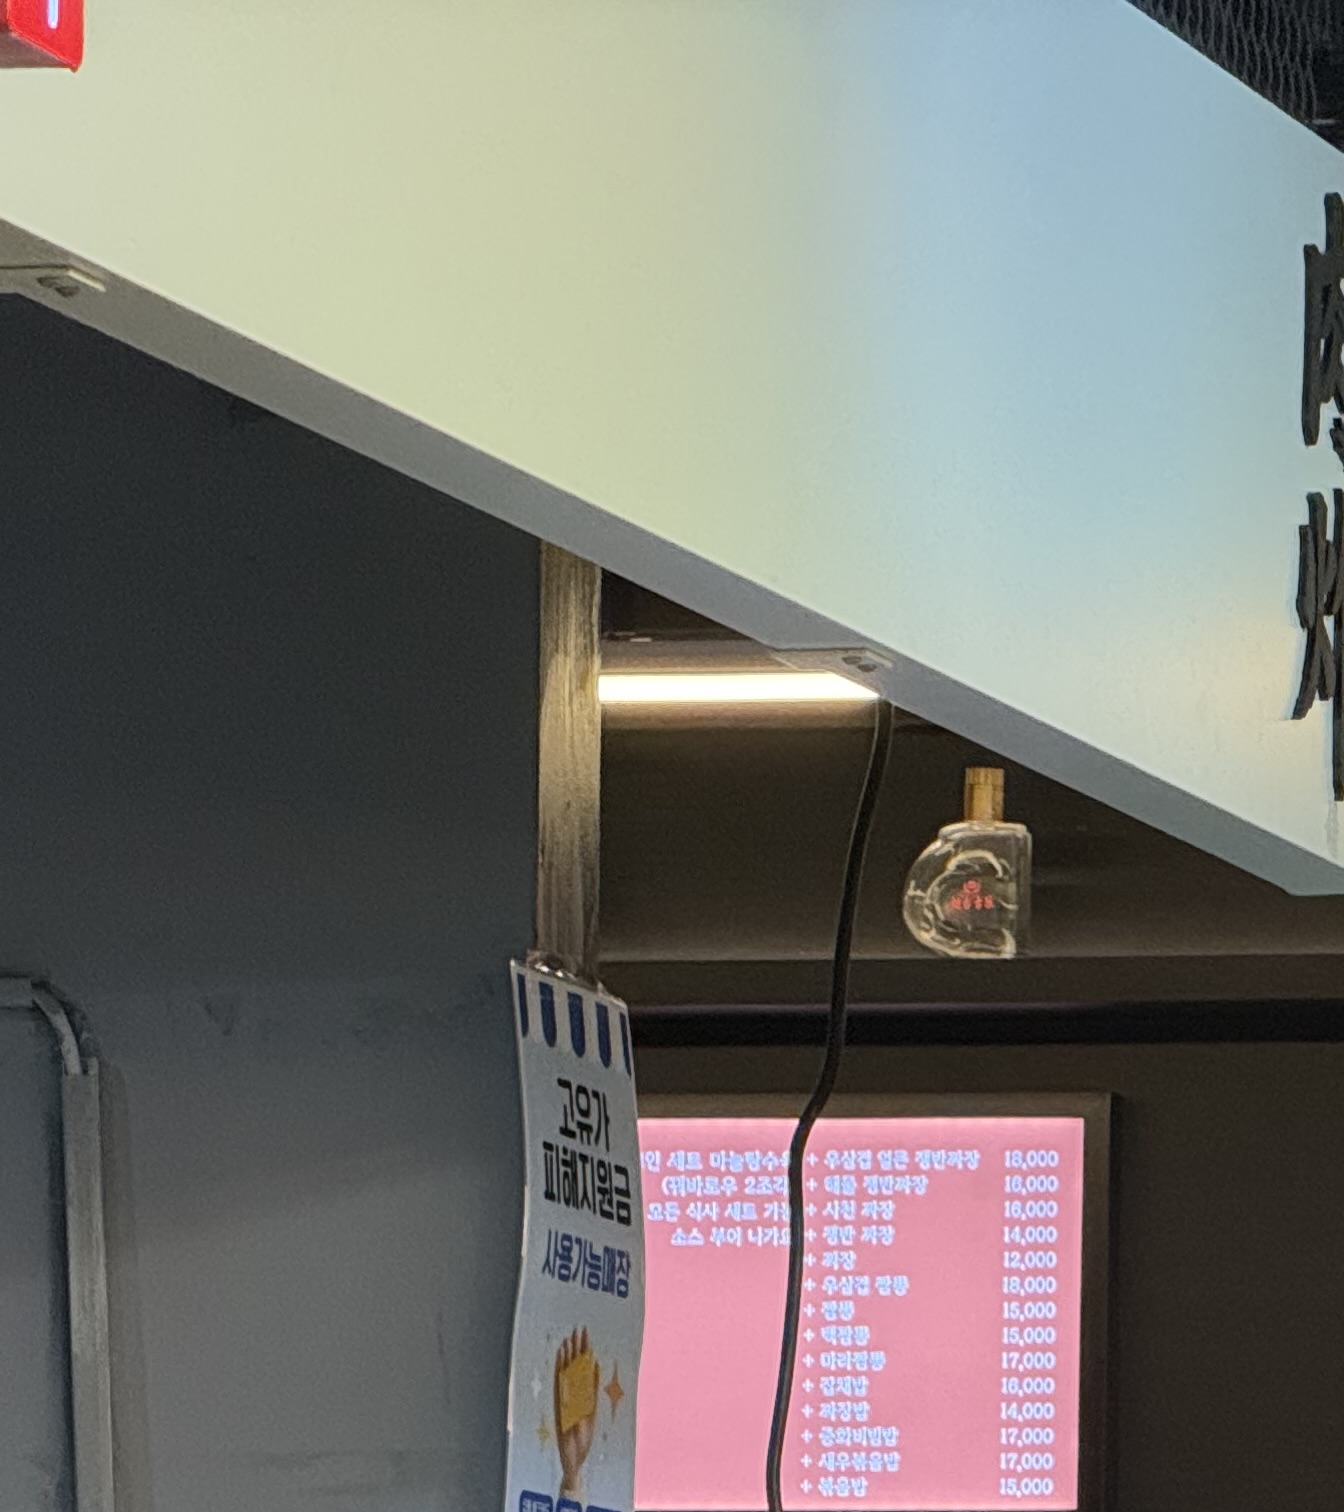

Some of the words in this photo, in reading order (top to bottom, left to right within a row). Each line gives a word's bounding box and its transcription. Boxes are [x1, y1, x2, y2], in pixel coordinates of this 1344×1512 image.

[557, 1077, 610, 1152] 고유가
[667, 1151, 703, 1171] 세트
[1004, 1150, 1058, 1170] 18,000
[542, 1140, 632, 1227] 피해지원금
[1004, 1176, 1058, 1195] 16,000
[648, 1202, 680, 1222] 모든
[686, 1202, 719, 1222] 식사
[725, 1202, 758, 1221] 세트
[1004, 1201, 1058, 1220] 16,000
[671, 1227, 704, 1246] 소스
[1003, 1226, 1057, 1246] 14,000
[541, 1229, 631, 1300] 사용가능매장
[1003, 1251, 1057, 1271] 12,000
[1003, 1276, 1057, 1296] 18,000
[1003, 1301, 1056, 1321] 15,000
[1002, 1327, 1056, 1346] 15,000
[1001, 1352, 1056, 1372] 17,000
[1001, 1377, 1056, 1397] 16,000
[1001, 1402, 1055, 1422] 14,000
[1000, 1427, 1055, 1447] 17,000
[1000, 1453, 1055, 1472] 17,000
[999, 1477, 1054, 1498] 15,000
